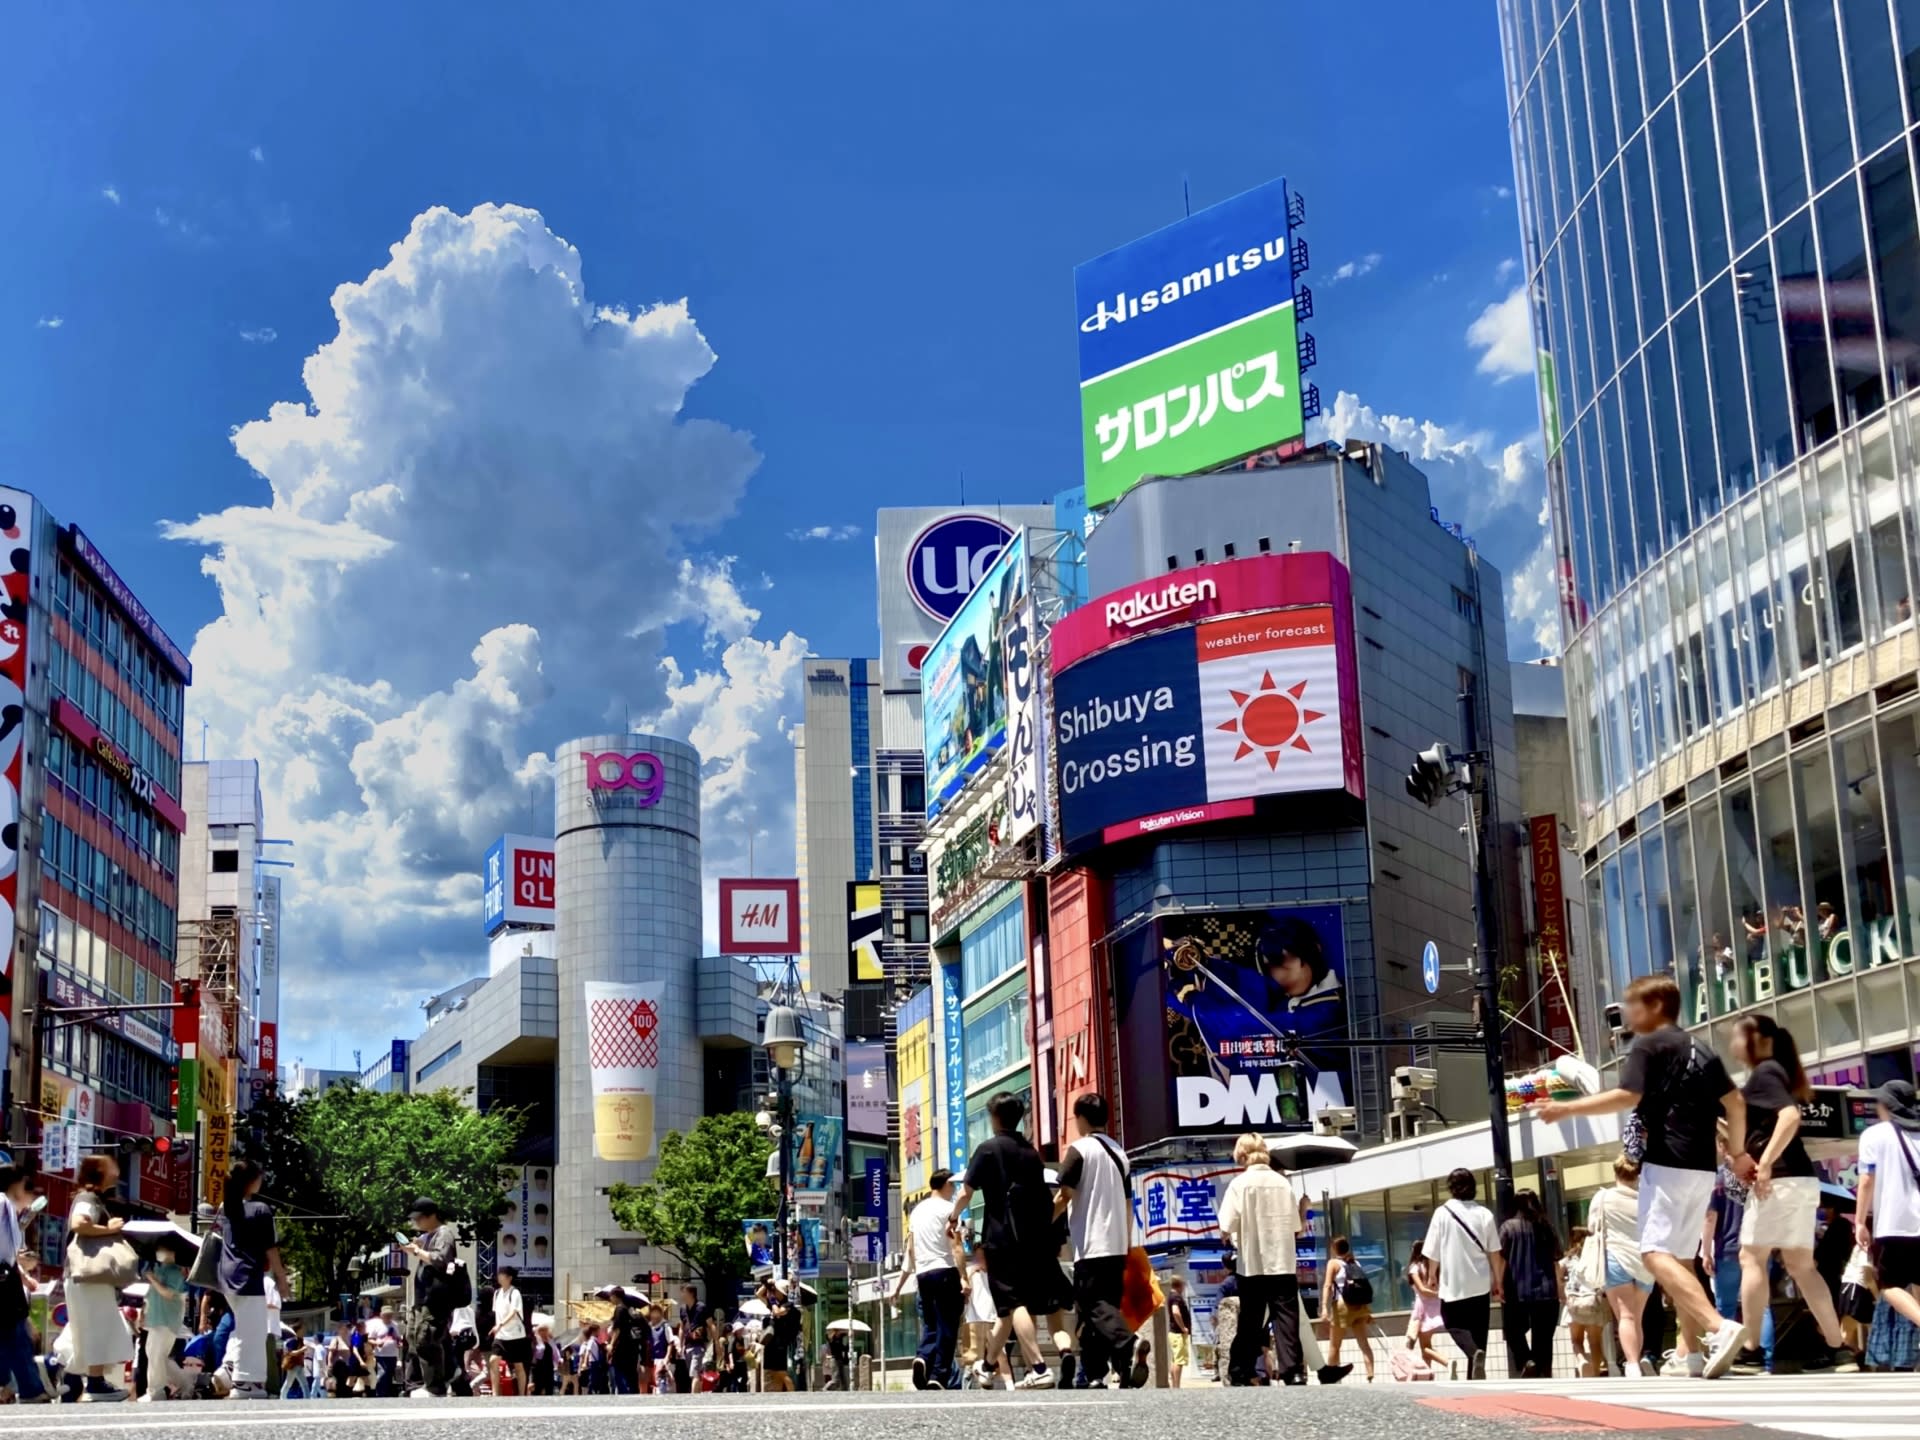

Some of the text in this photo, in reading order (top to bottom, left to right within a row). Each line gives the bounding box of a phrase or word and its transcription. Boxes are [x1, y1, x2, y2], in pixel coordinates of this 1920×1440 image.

[1080, 237, 1285, 333] Hisamitsu
[1095, 350, 1285, 463] サロンパス
[1106, 578, 1217, 628] Rakuten
[1205, 623, 1326, 649] weather forecast
[1006, 611, 1036, 824] もんじゃ
[1059, 686, 1174, 744] Shibuya
[580, 751, 665, 808] 109
[1062, 734, 1197, 794] Crossing
[1139, 809, 1204, 831] Rakuten Vision
[740, 903, 780, 929] H&M
[262, 1035, 274, 1061] 免税
[633, 1014, 653, 1029] 100
[945, 993, 965, 1143] サマーフルーツギフト
[872, 1168, 882, 1207] MIZUHO
